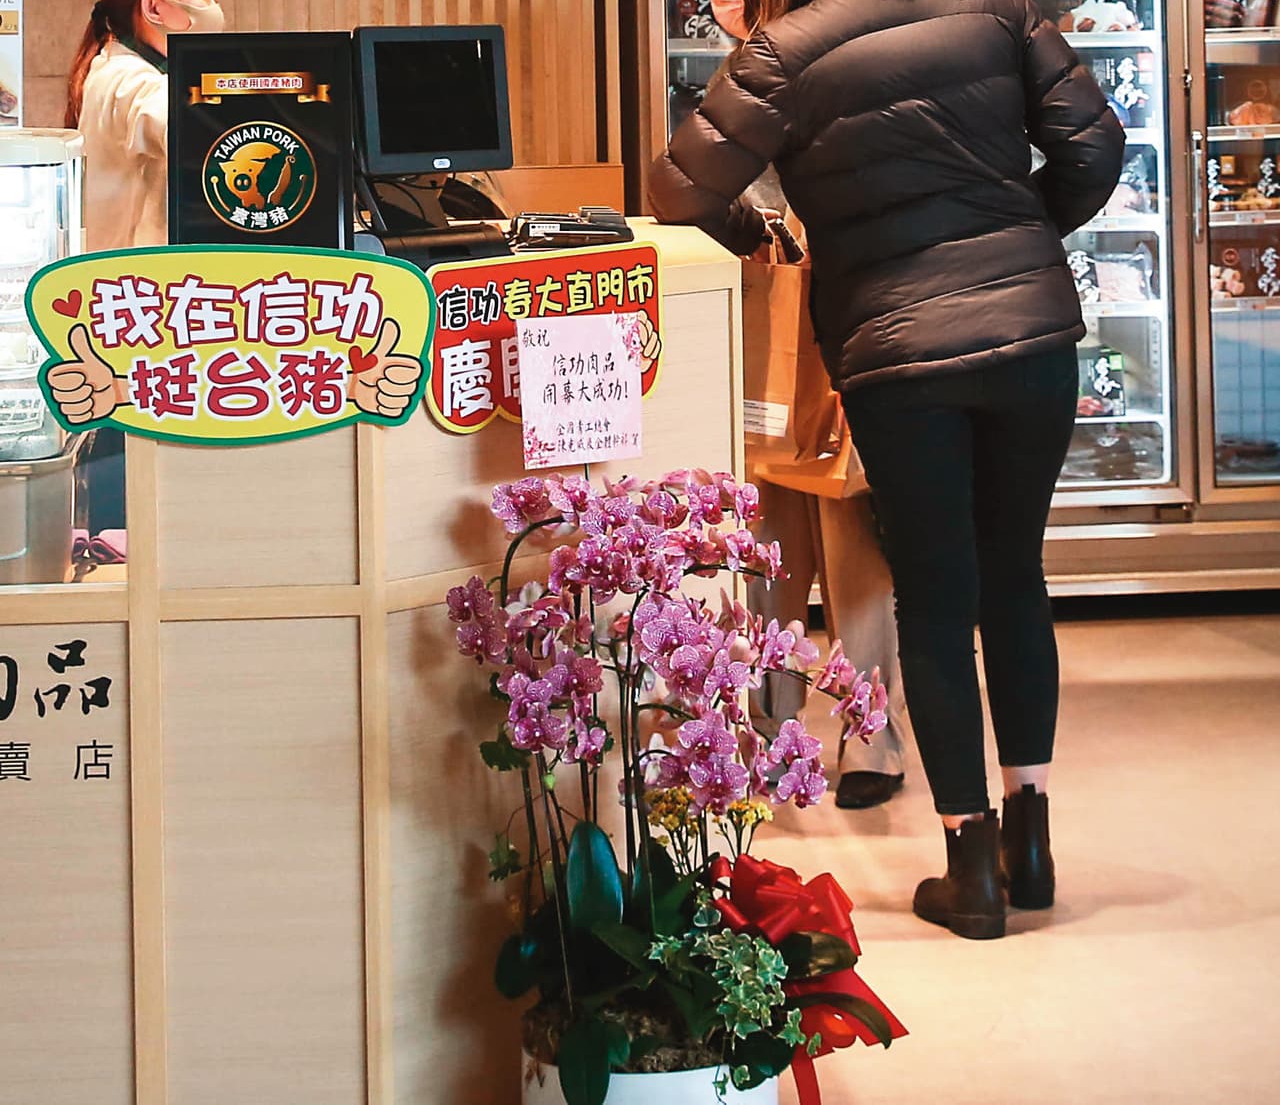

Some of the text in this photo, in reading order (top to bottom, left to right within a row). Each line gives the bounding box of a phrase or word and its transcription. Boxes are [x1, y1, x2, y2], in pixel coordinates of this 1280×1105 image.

[214, 126, 300, 160] TAIWAN PORK
[90, 272, 384, 347] 我在信功
[436, 263, 654, 330] 信功春大直門市
[127, 350, 349, 420] 挺台豬
[552, 352, 616, 377] 信功肉品
